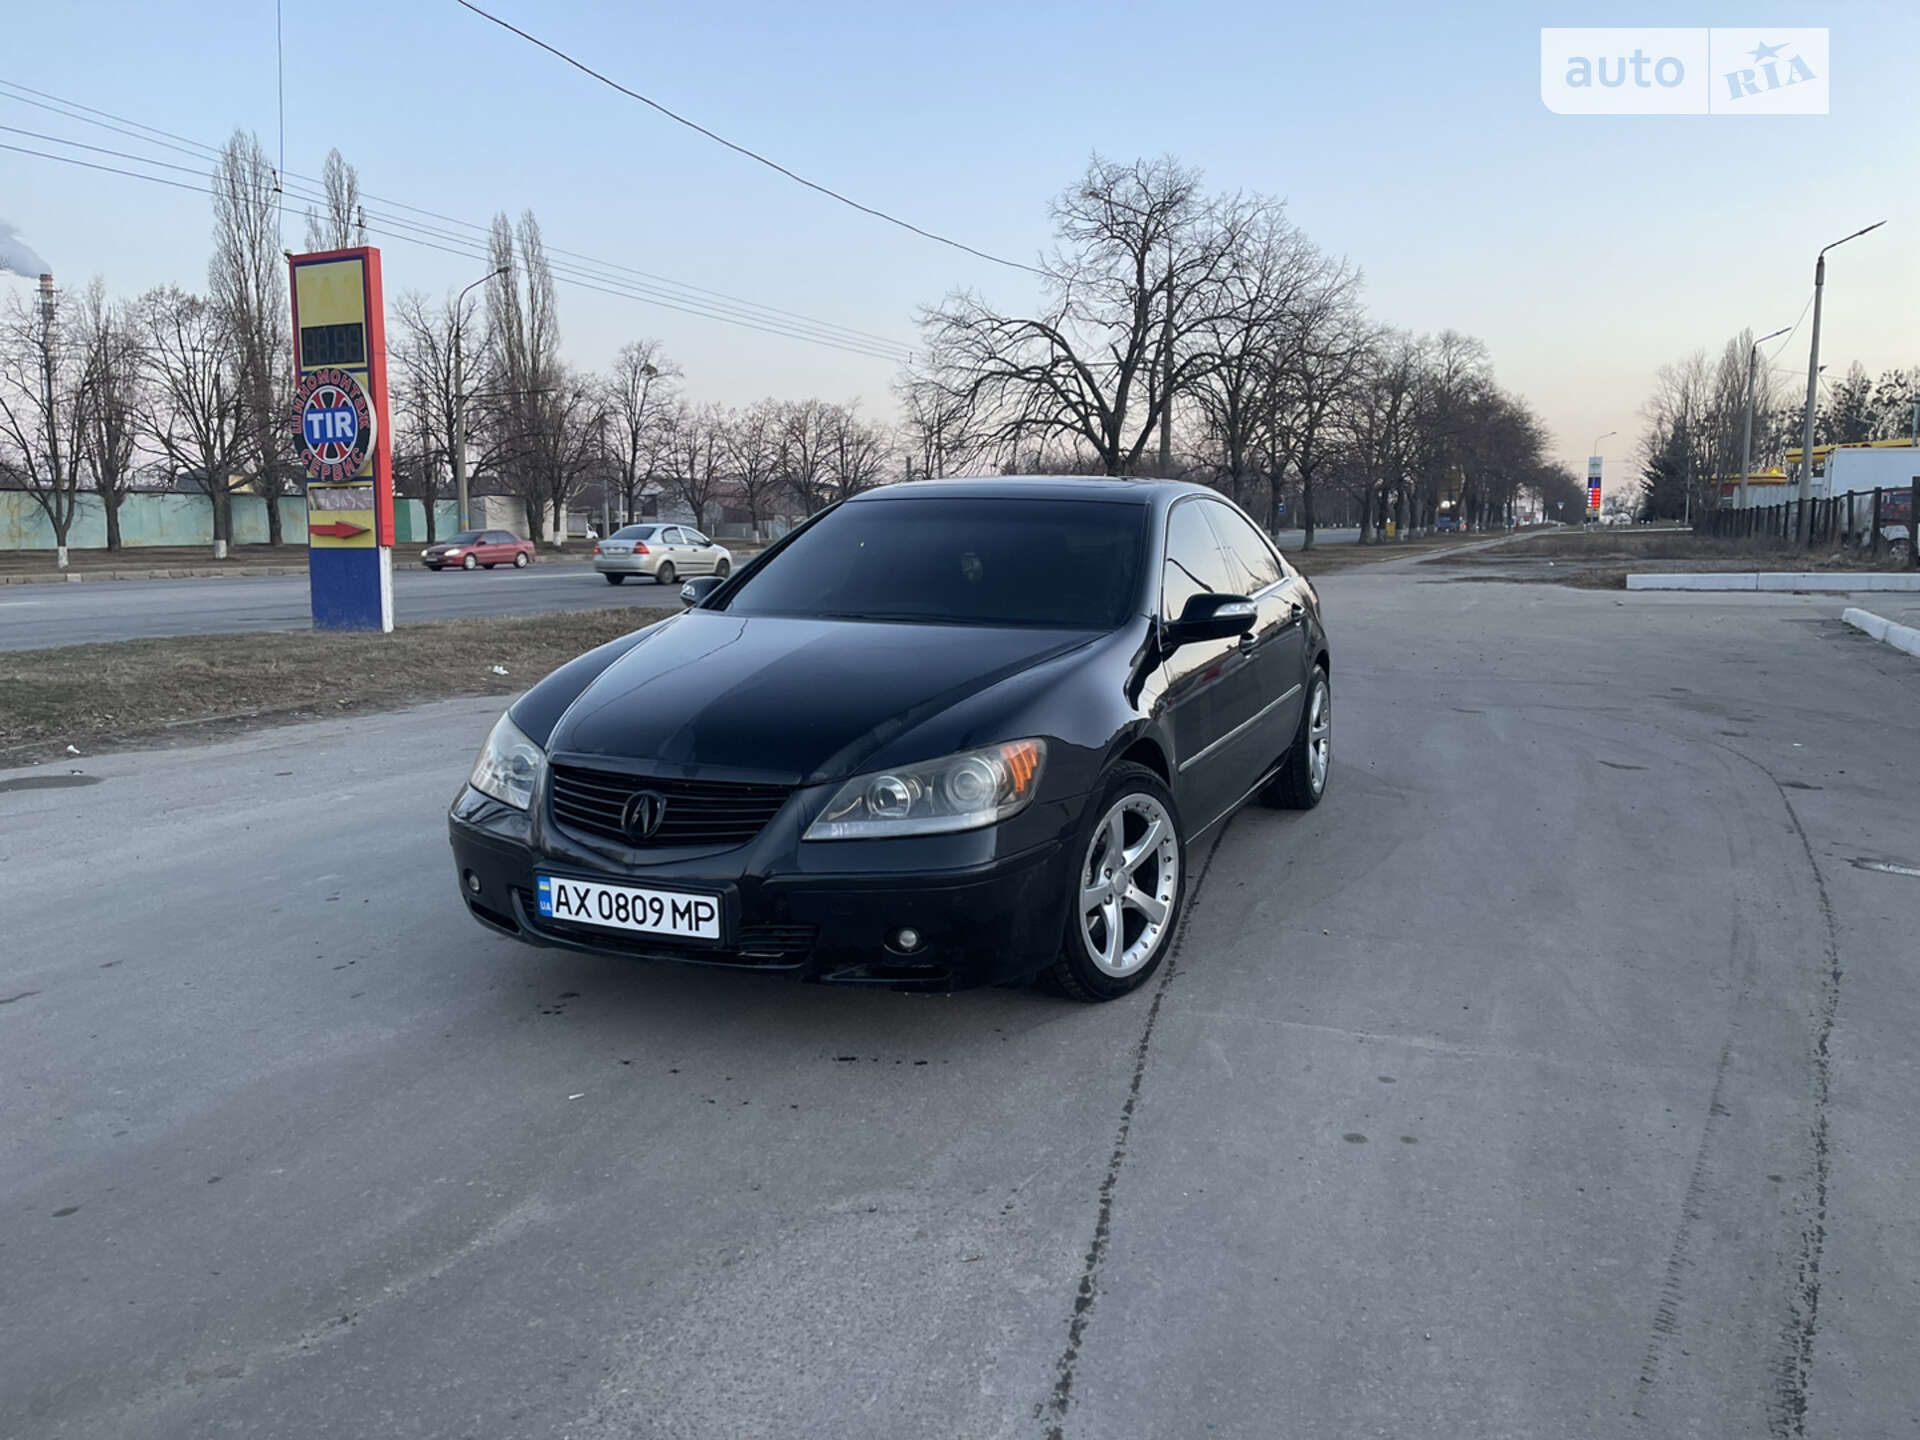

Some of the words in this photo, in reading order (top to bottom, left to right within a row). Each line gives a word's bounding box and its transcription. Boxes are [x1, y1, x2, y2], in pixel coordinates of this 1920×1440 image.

[292, 368, 370, 433] ШИНОМОНТАЖ
[307, 411, 354, 439] TIR
[301, 448, 364, 481] СЕРВИС
[555, 884, 592, 918] AX
[598, 890, 665, 927] 0809
[671, 898, 716, 932] MP
